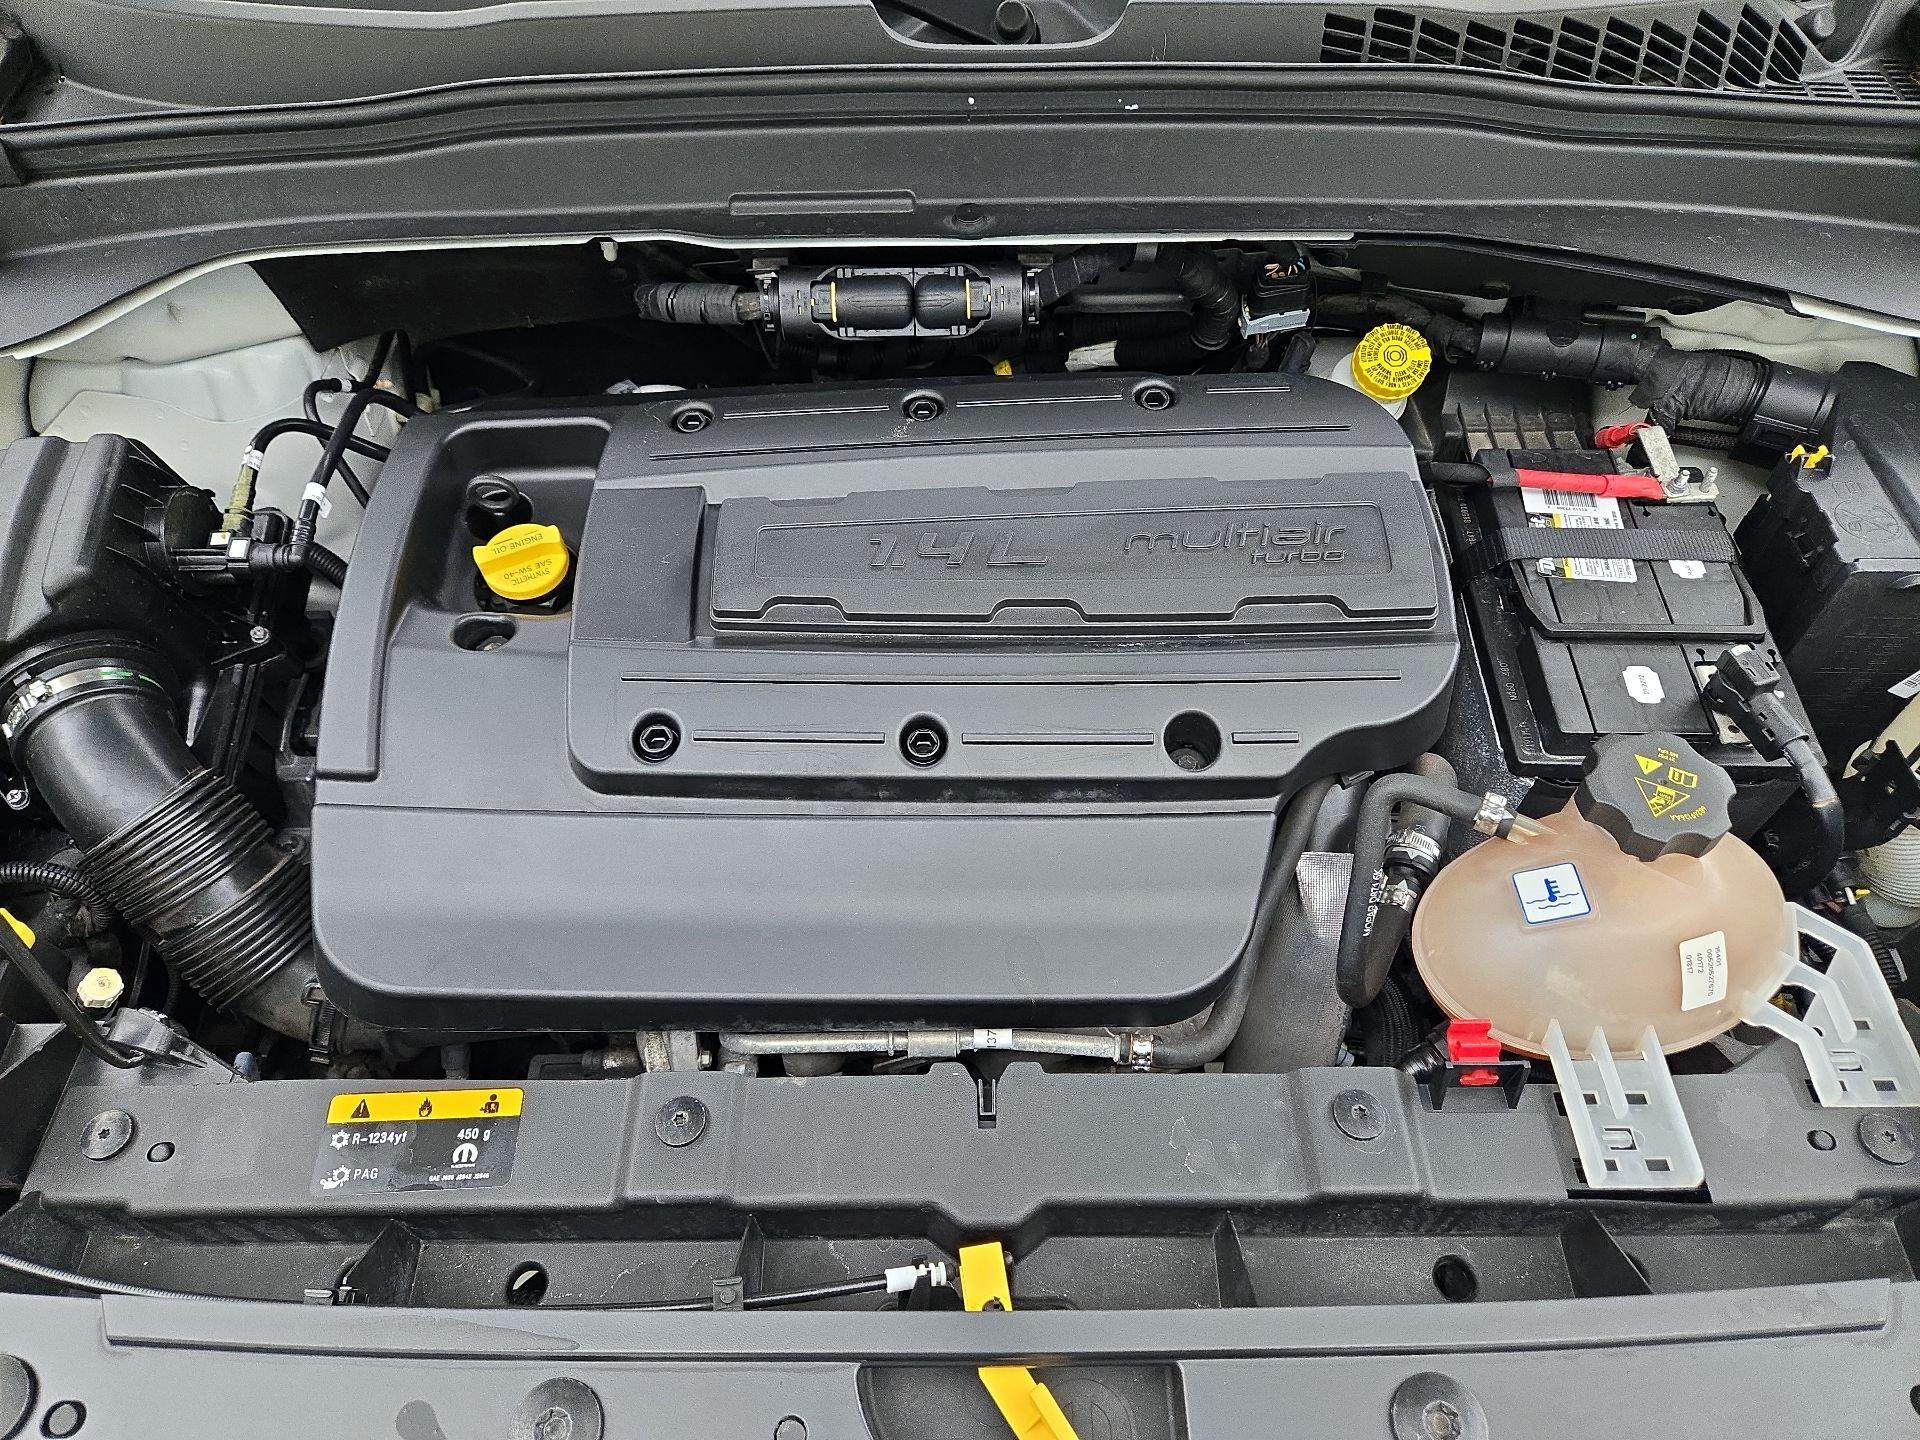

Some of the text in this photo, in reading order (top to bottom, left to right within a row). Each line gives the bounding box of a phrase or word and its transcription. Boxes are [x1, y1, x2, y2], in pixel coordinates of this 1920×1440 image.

[492, 533, 543, 555] ENGINE OIL
[1124, 520, 1347, 551] multiair
[1250, 547, 1347, 565] turbo
[503, 558, 552, 580] SAE 5W-40
[511, 568, 550, 586] SYNTHETIC
[1362, 905, 1377, 937] MOPAR
[352, 1128, 491, 1146] R-1234yf 450 g
[353, 1168, 379, 1180] PAG
